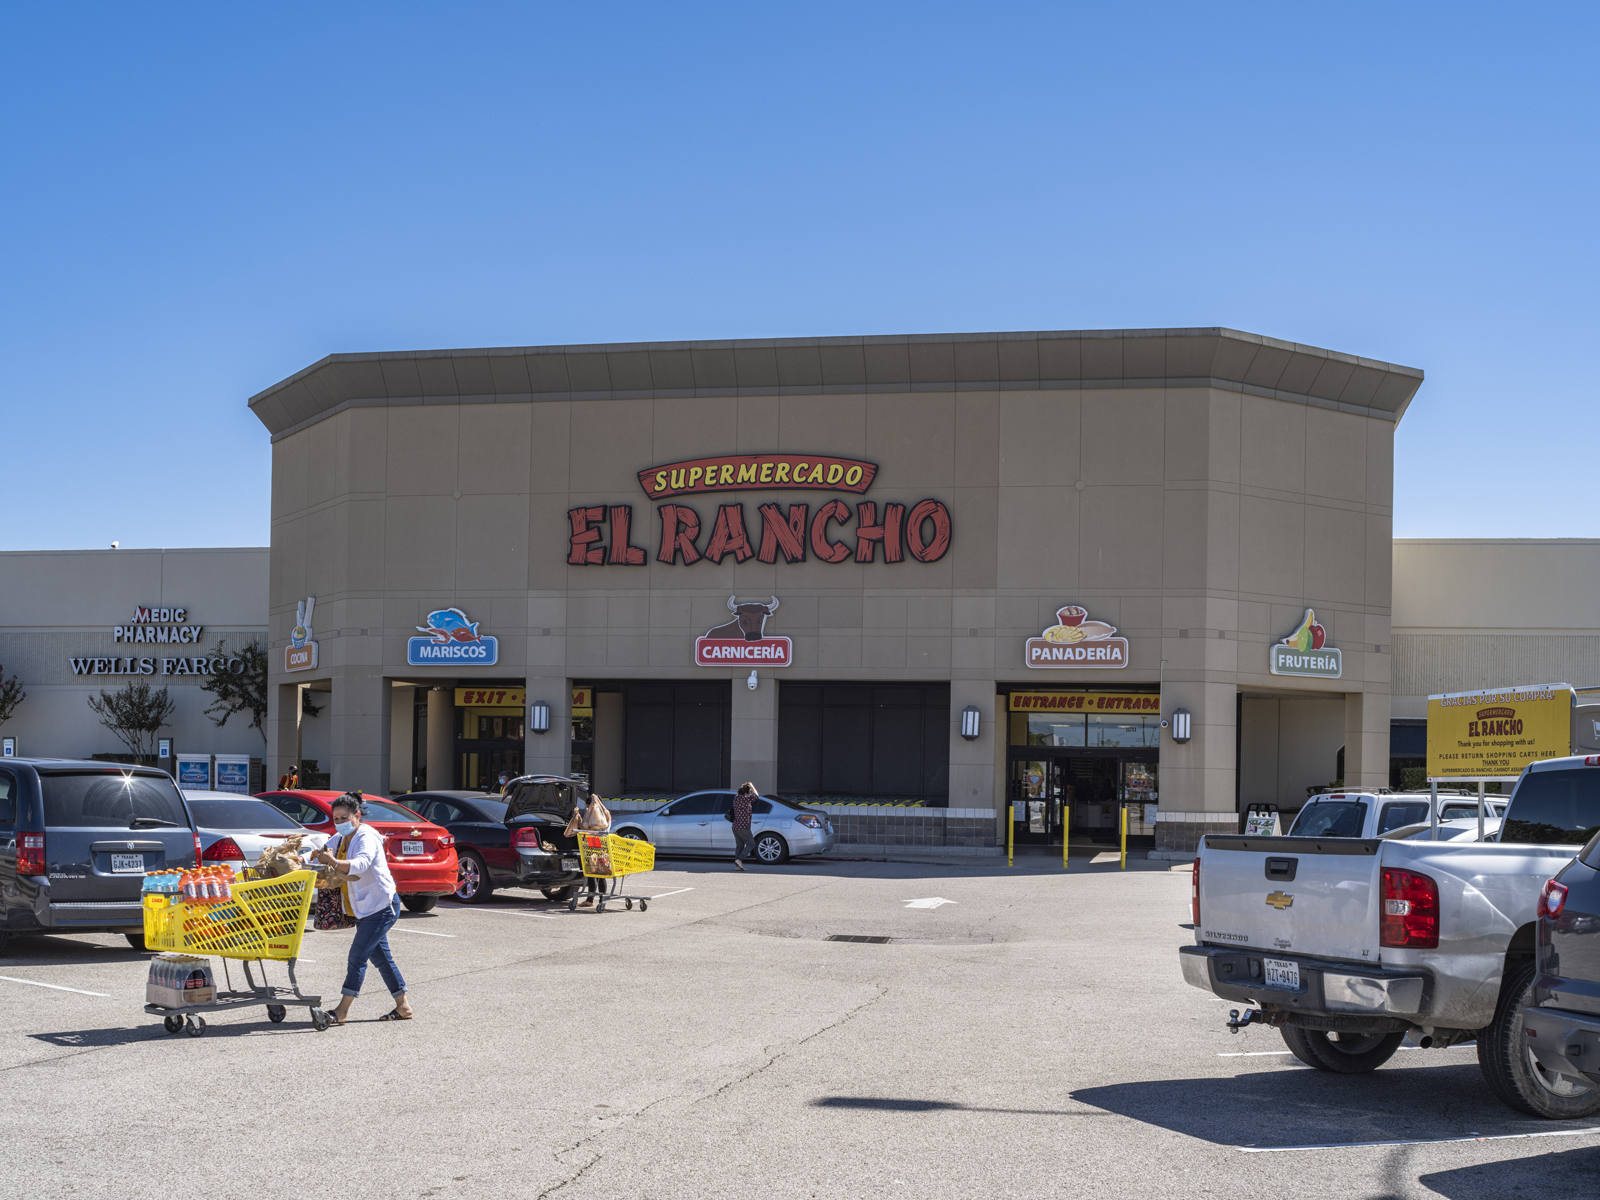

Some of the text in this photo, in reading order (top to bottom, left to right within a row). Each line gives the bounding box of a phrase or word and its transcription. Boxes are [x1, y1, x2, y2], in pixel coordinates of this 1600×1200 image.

[653, 462, 863, 491] SUPERMERCADO
[567, 499, 952, 566] EL RANCHO
[131, 606, 186, 624] MEDIC
[113, 626, 202, 643] PHARMACY
[419, 645, 486, 658] MARISCOS
[702, 643, 785, 660] CARNICERÍA
[1031, 644, 1122, 661] PANADERÍA
[69, 657, 245, 675] WELLS FARGO
[1278, 653, 1338, 671] FRUTERÍA
[463, 691, 506, 704] EXIT
[1013, 695, 1161, 710] ENTRANCE ENTRADA
[1440, 689, 1556, 707] GRACIAS POR SU COMPRA!
[1468, 719, 1523, 737] EL RANCHO
[1491, 740, 1514, 748] shopping
